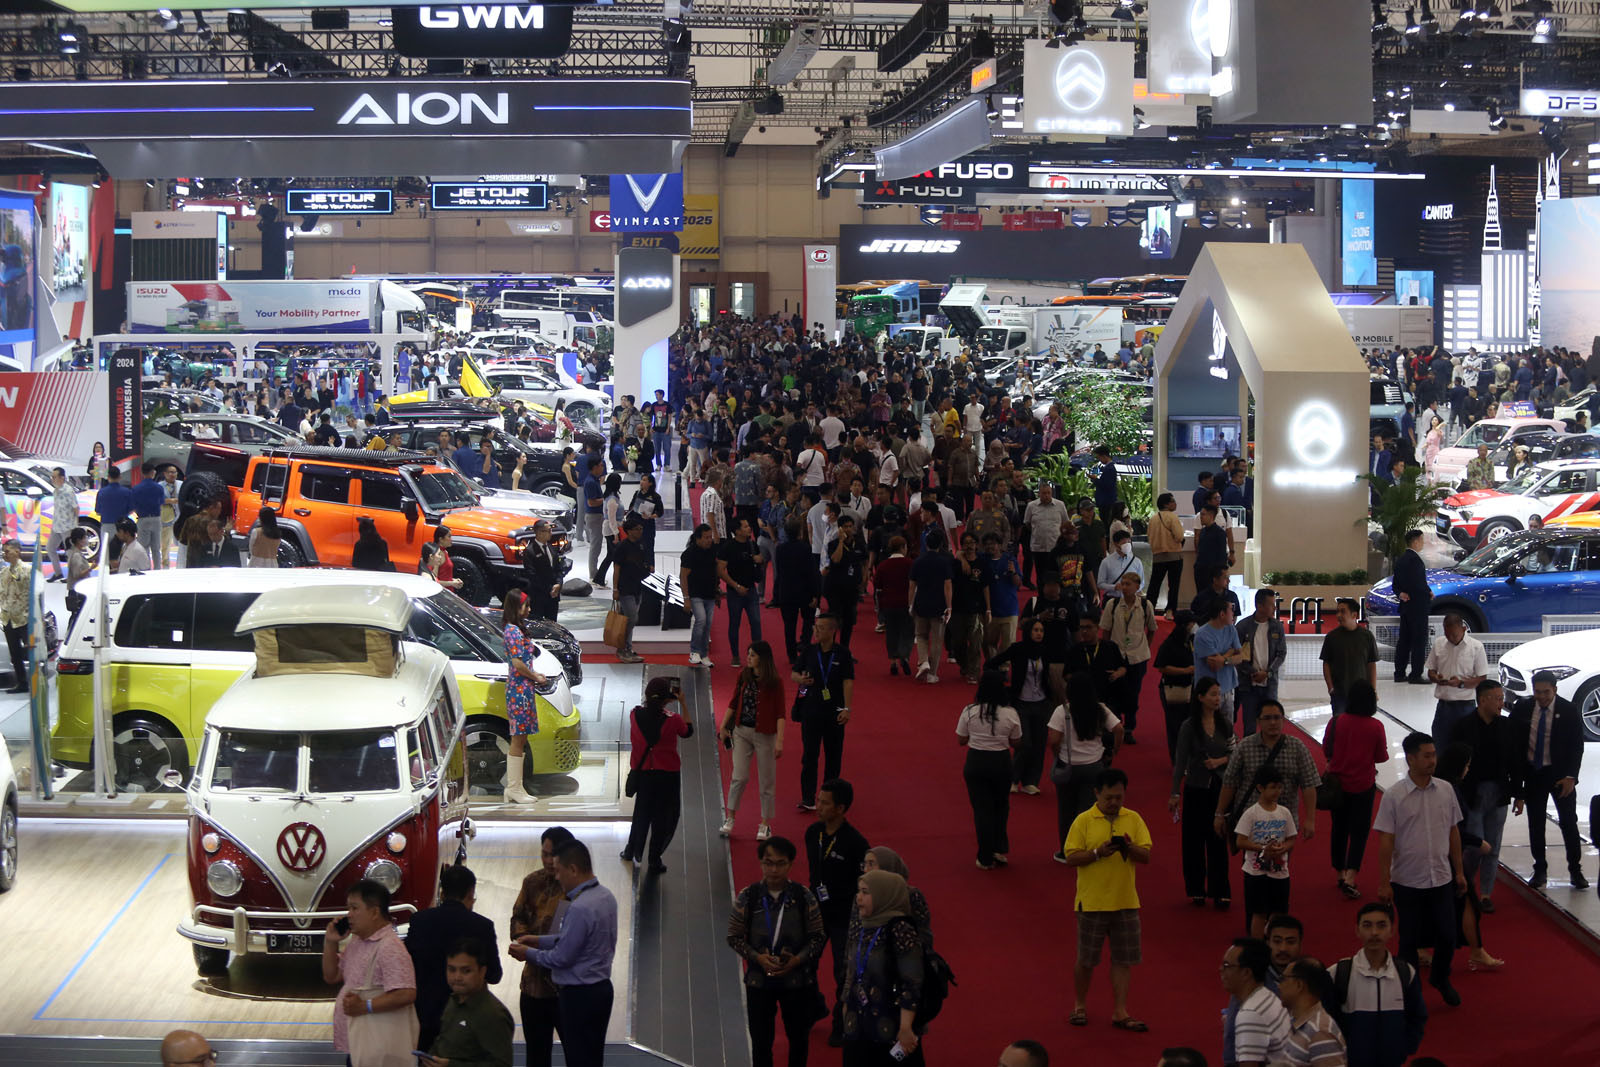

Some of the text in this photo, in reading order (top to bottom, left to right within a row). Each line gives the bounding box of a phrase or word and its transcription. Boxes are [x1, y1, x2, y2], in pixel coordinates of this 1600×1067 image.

[420, 5, 544, 29] GWM
[337, 92, 508, 125] AION
[939, 163, 1014, 179] FUSO
[450, 187, 529, 197] JETOUR
[303, 193, 376, 203] JETOUR
[613, 216, 680, 226] VINFAST
[632, 237, 663, 247] EXIT
[859, 239, 961, 253] JETBUS
[622, 278, 671, 289] AION
[255, 309, 361, 319] Your Mobility Partner
[116, 358, 134, 367] 2024
[116, 387, 124, 450] ASSEMBLED
[124, 378, 132, 449] IN INDONESIA
[270, 935, 312, 947] B 7591
